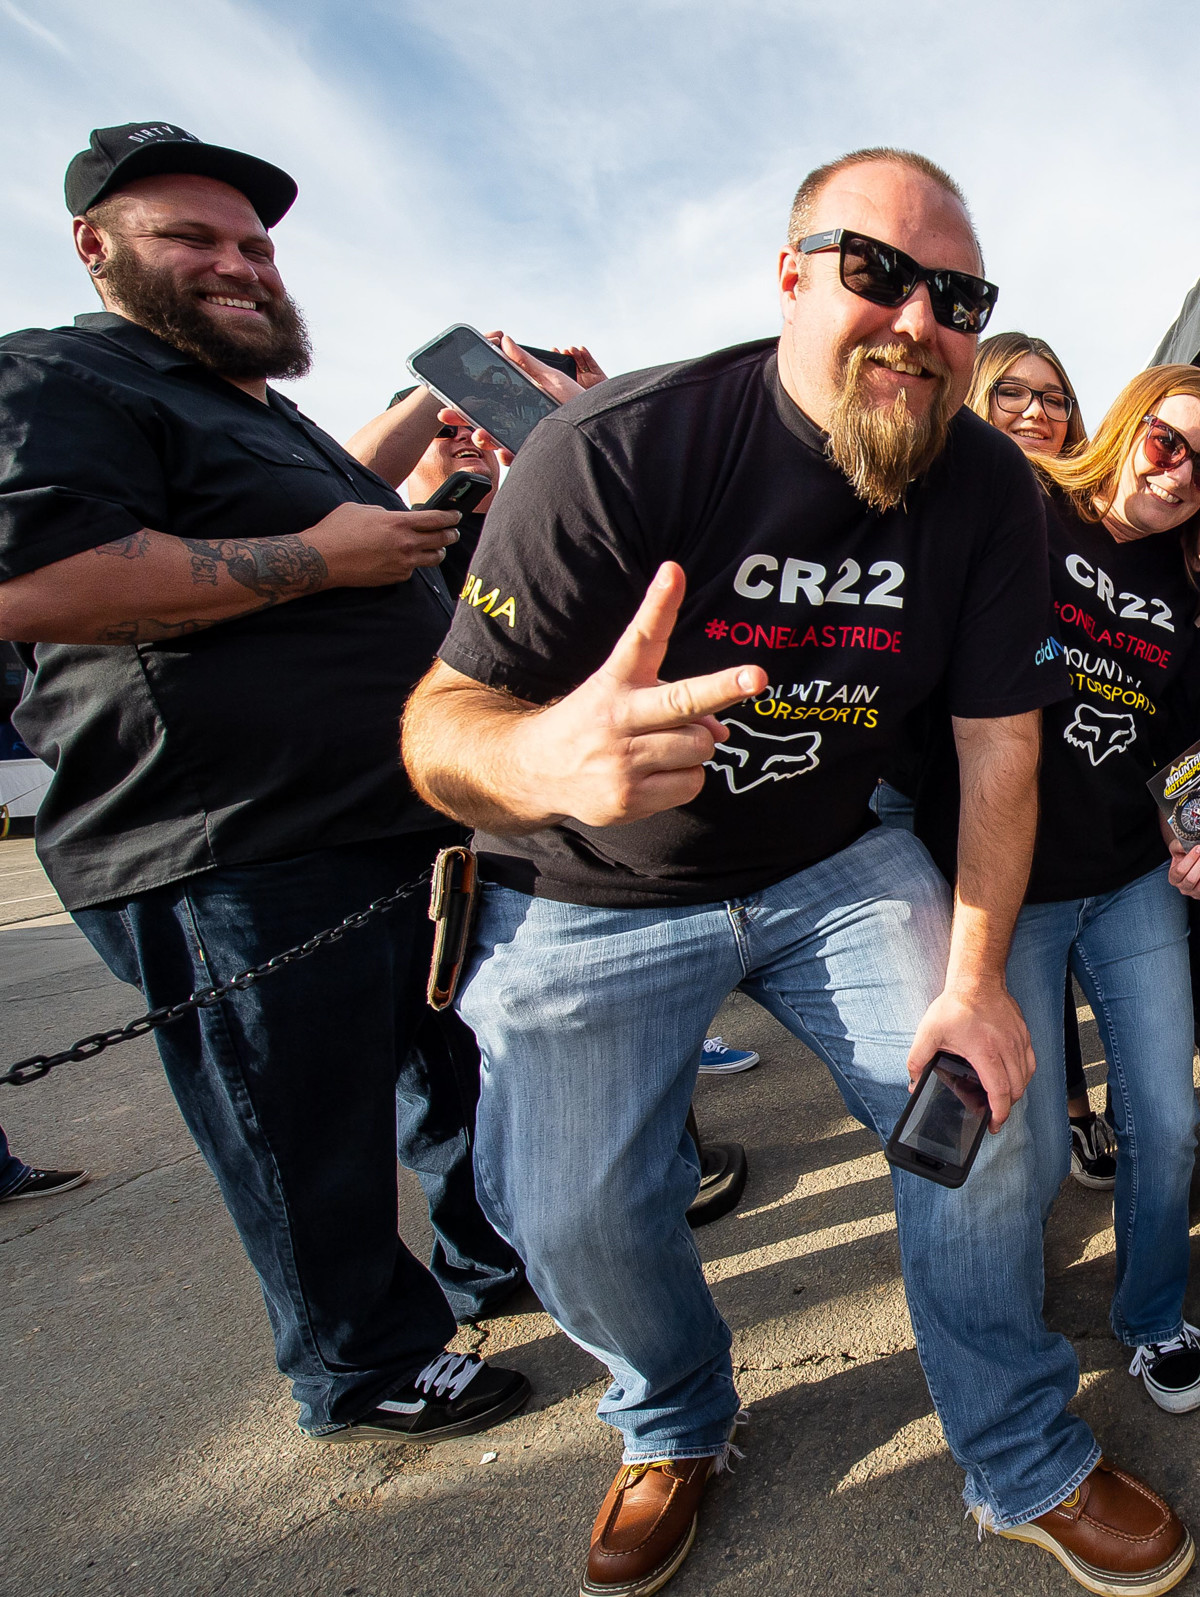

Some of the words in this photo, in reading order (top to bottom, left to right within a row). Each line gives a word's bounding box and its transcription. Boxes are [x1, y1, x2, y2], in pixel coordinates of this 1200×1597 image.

[127, 125, 175, 144] DIRTY
[733, 553, 905, 609] CR22
[1065, 553, 1175, 633] CR22
[704, 618, 903, 653] #ONELASTRIDE
[754, 698, 879, 729] ORSPORTS
